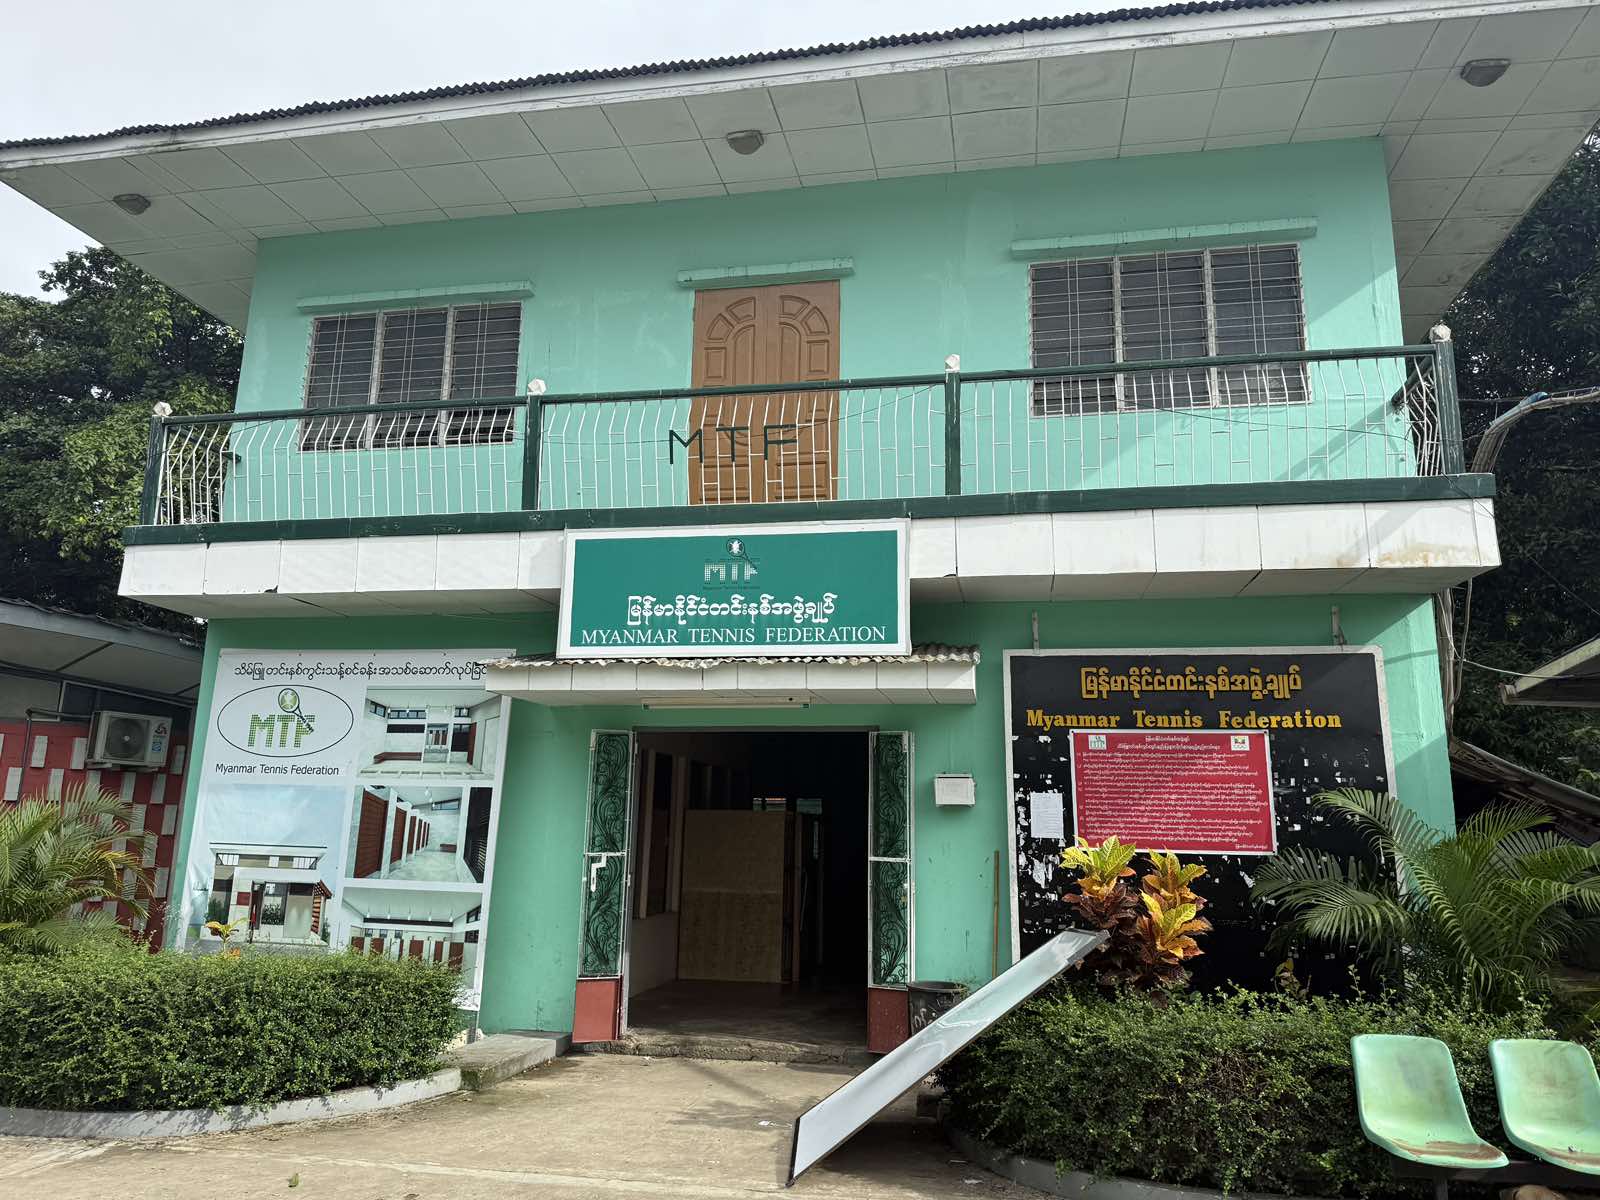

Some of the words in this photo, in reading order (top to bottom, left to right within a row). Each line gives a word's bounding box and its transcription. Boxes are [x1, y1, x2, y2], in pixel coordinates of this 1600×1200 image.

[669, 425, 799, 464] MTF
[581, 628, 680, 645] MYANMAR
[688, 627, 756, 643] TENNIS
[765, 625, 887, 643] FEDERATION
[247, 714, 316, 748] MTF
[1026, 708, 1120, 731] Myanmar
[1132, 708, 1204, 728] Tennis
[1218, 708, 1342, 729] Federation
[215, 763, 257, 775] Myanmar
[259, 764, 288, 775] Tennis
[290, 764, 340, 776] Federation
